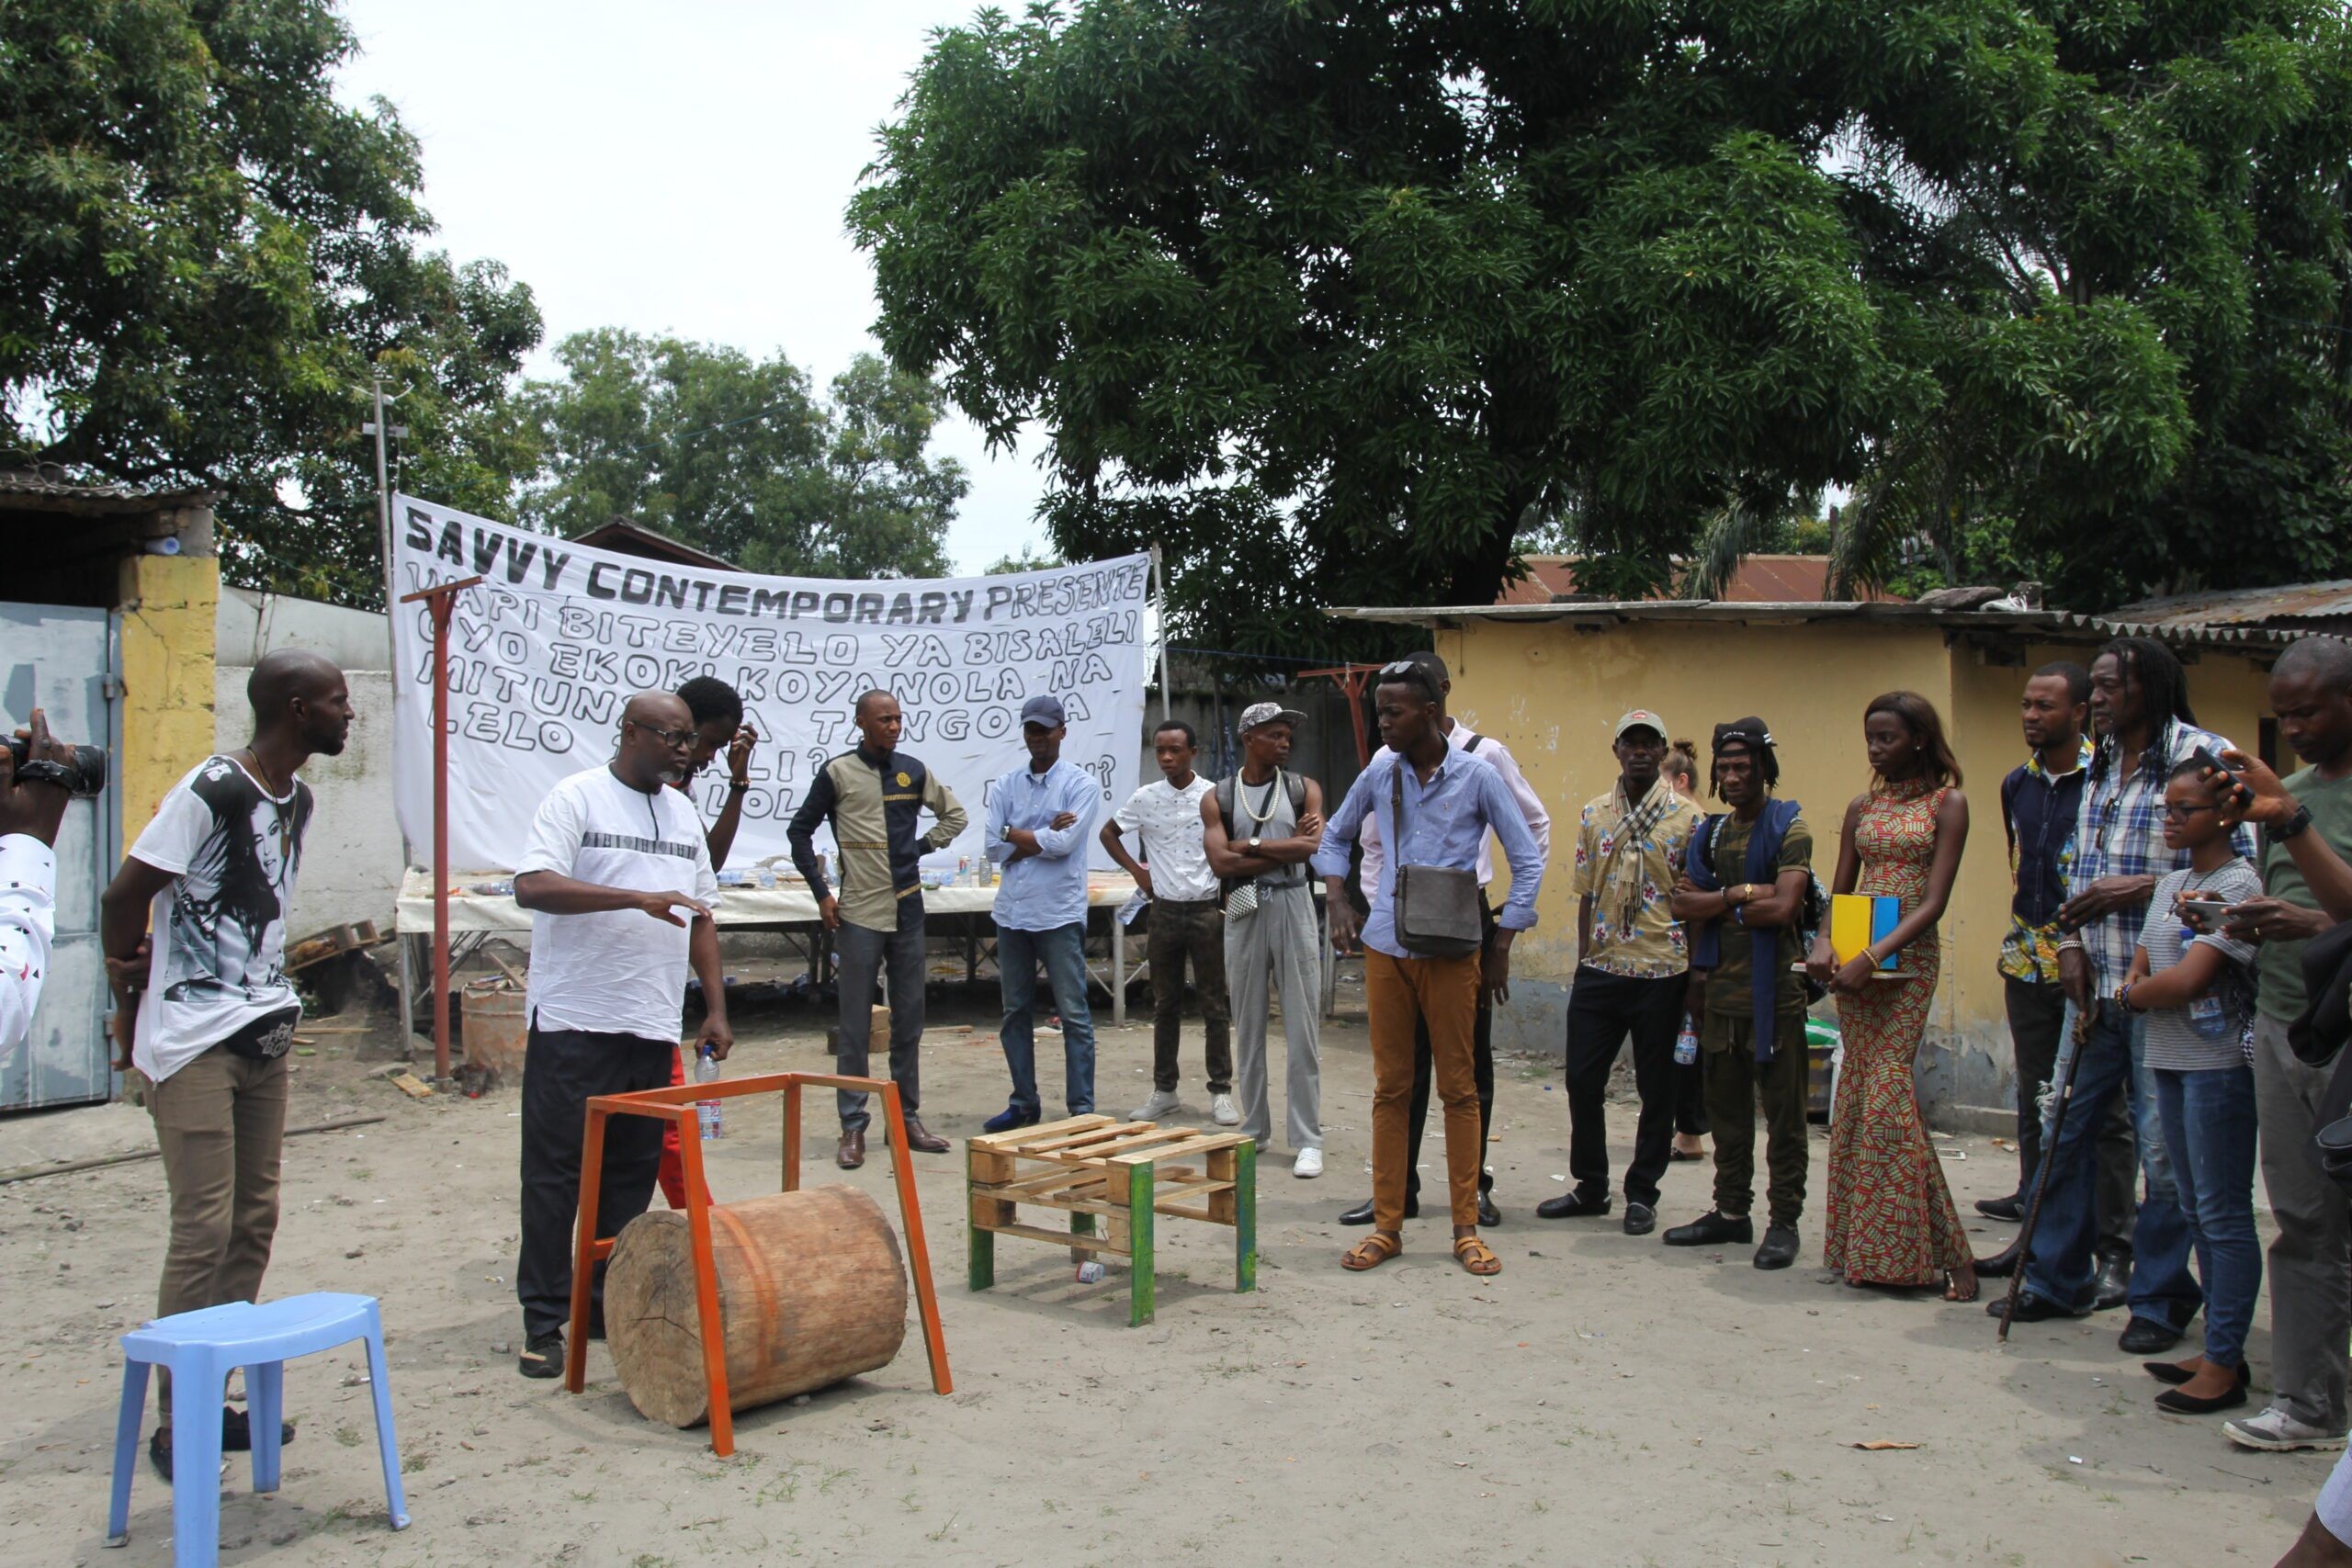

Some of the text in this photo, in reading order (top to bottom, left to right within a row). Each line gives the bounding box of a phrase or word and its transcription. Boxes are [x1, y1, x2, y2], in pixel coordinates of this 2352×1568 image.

[406, 506, 1148, 625] SAVVY CONTEMPORARY PRESENTE
[559, 606, 859, 666] BITEYELO
[880, 633, 952, 668] YA
[963, 610, 1137, 666] BISALELI
[736, 667, 1025, 705] KOYANOLA
[1049, 653, 1113, 694] NA
